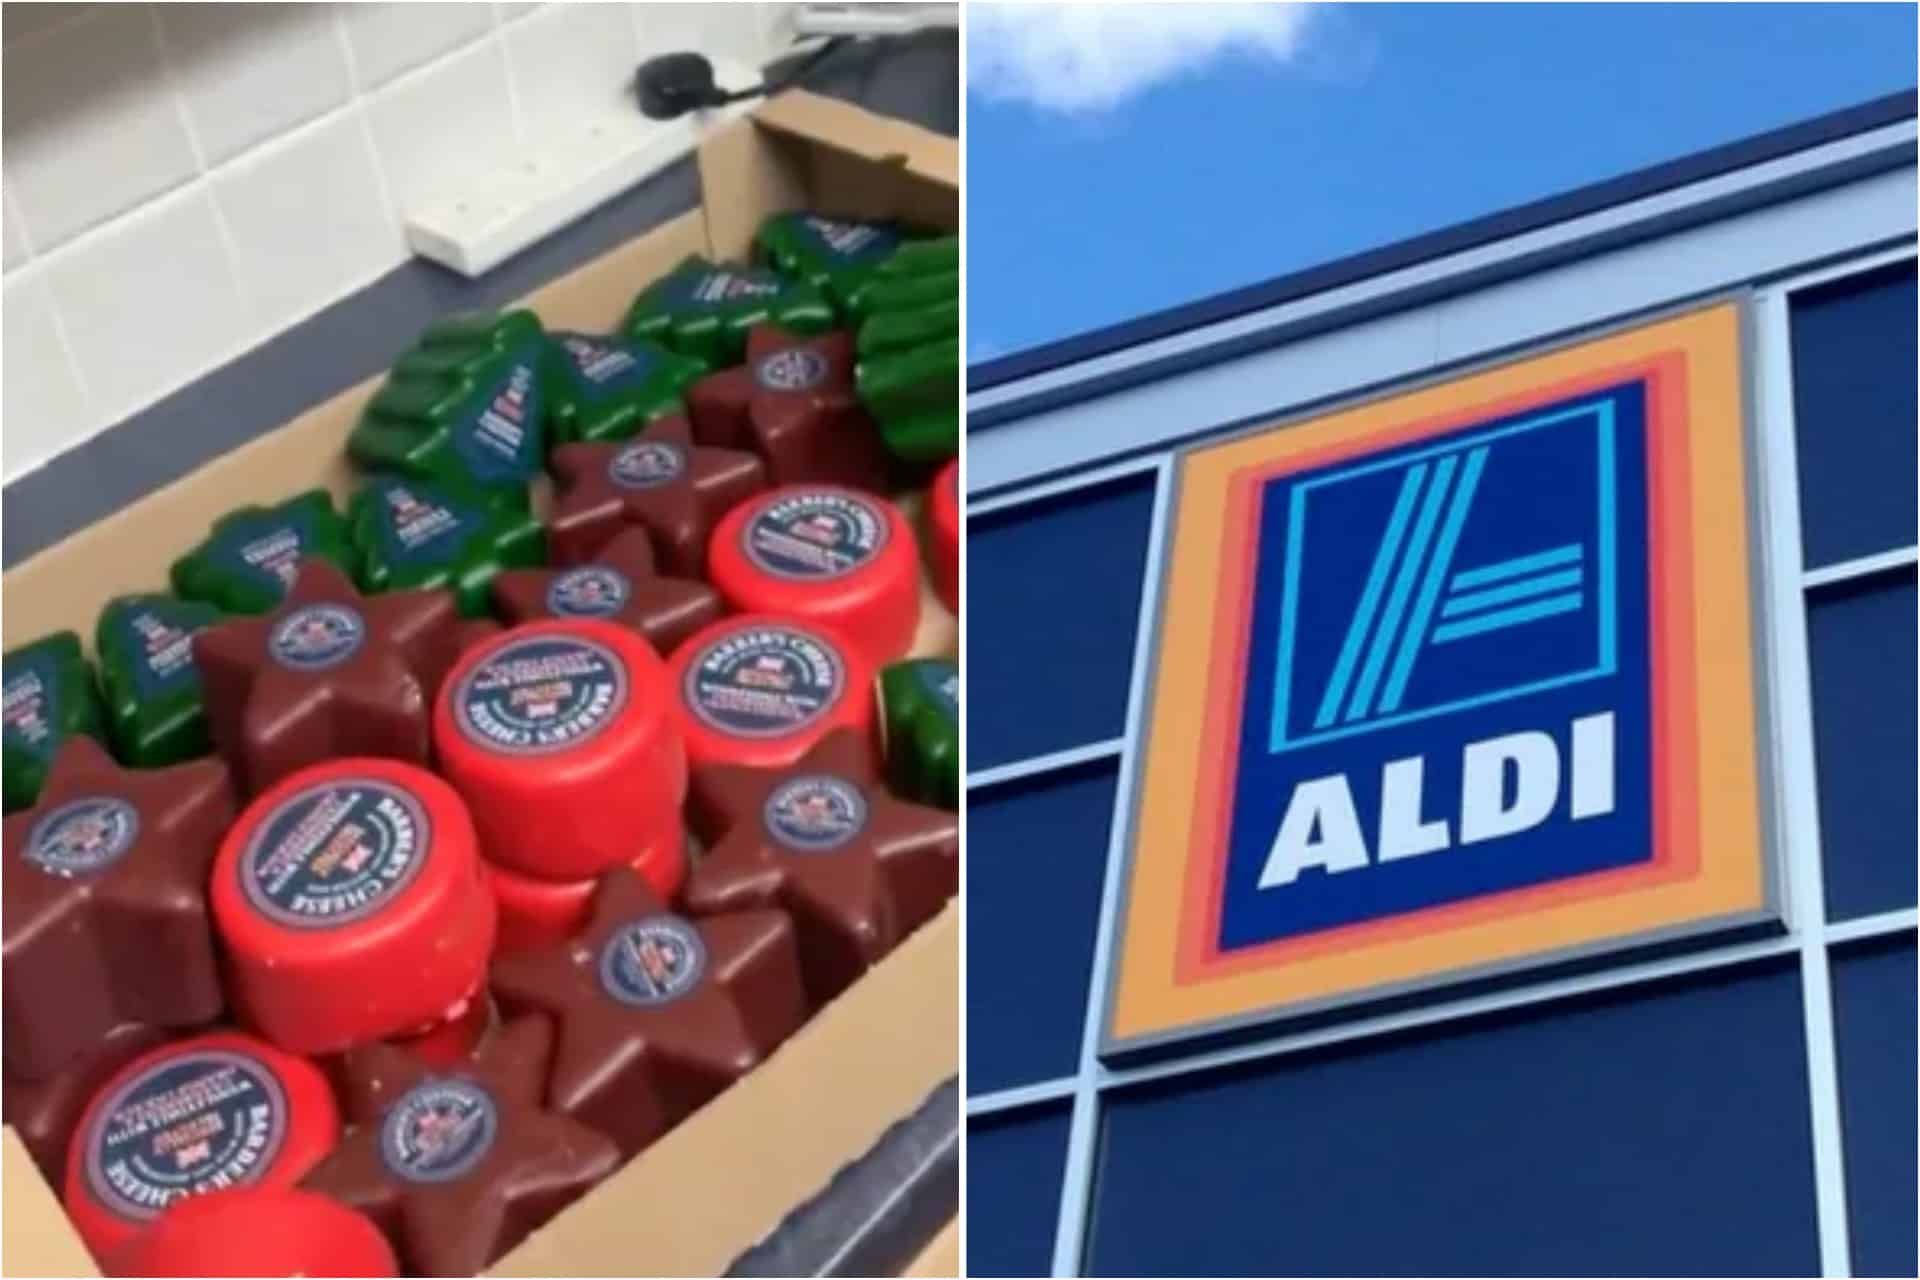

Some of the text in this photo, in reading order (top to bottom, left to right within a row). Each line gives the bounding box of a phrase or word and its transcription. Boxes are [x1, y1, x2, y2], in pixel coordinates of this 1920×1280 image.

[703, 632, 787, 671] BARBER'S
[469, 702, 532, 744] CHEESE
[537, 683, 612, 744] BARBER'S
[1257, 711, 1615, 890] ALDI
[376, 797, 413, 879] BARBER'S
[290, 879, 383, 915] CHEESE
